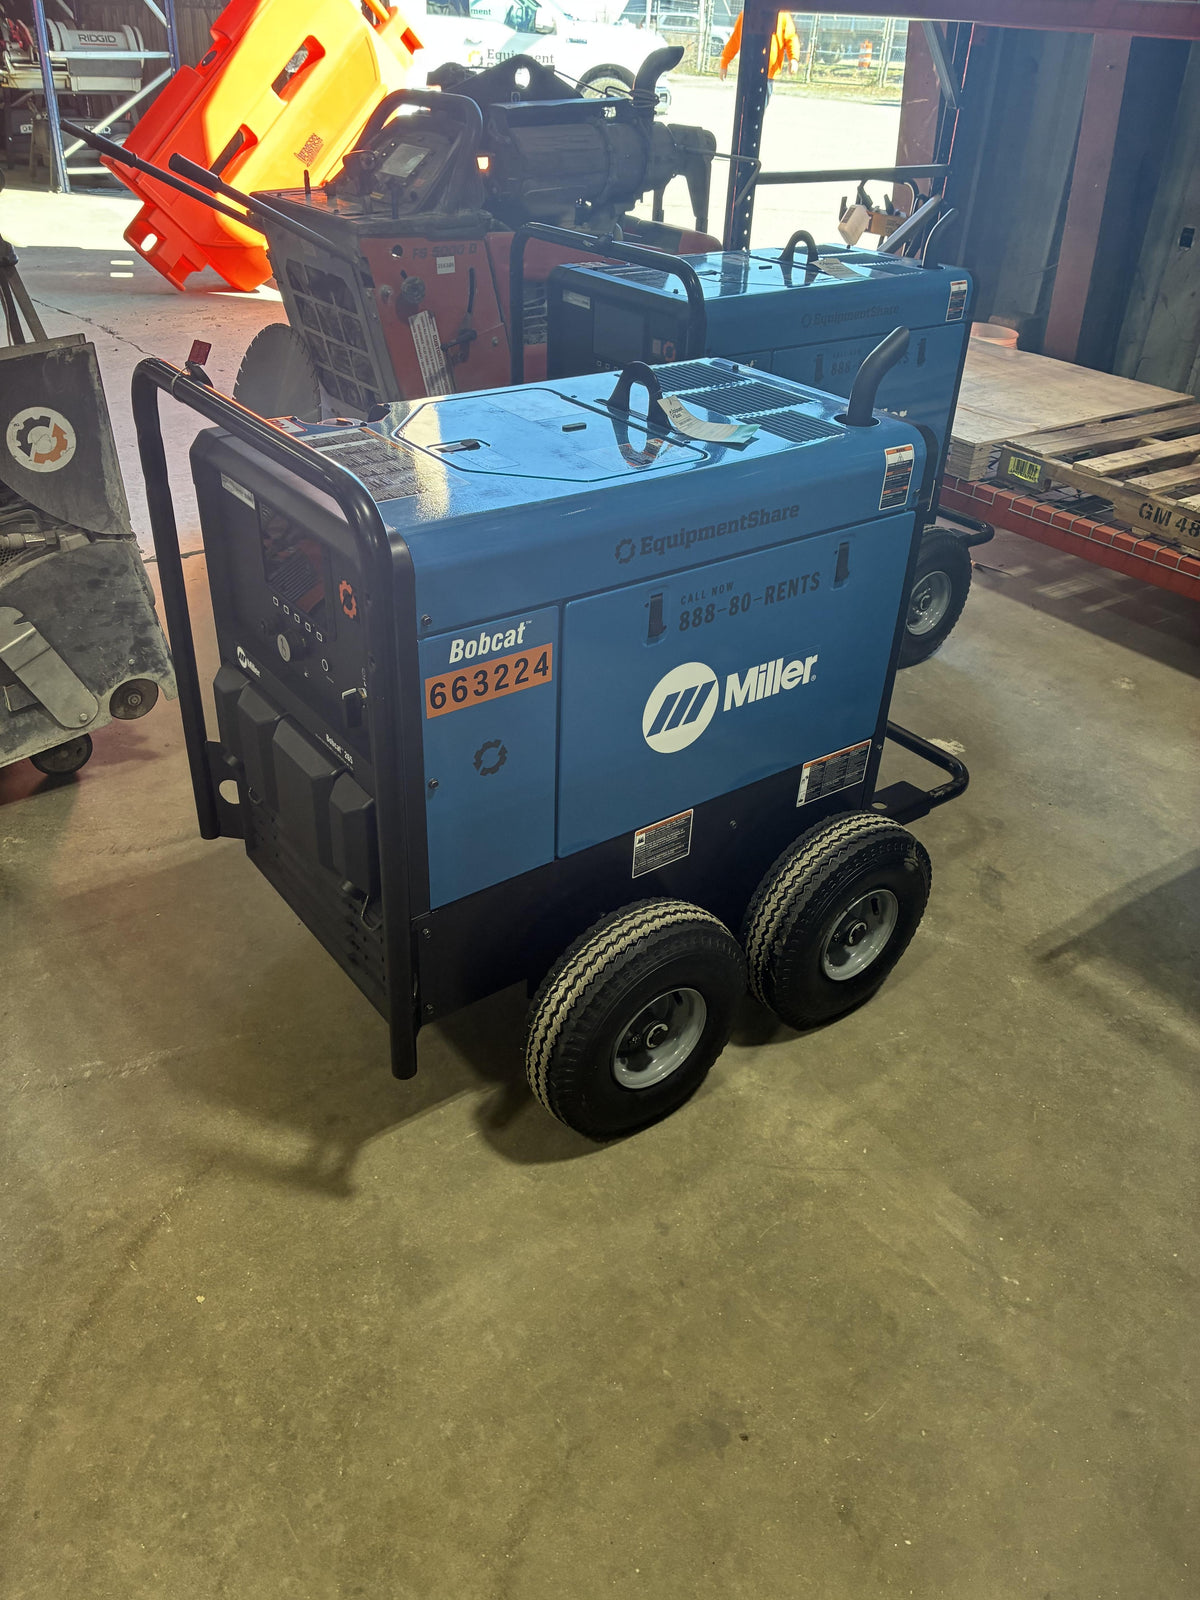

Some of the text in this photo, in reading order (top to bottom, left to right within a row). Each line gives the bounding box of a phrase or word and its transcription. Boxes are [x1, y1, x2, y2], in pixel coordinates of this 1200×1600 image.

[78, 33, 117, 43] RIDGID
[487, 49, 554, 64] Equient
[813, 305, 900, 327] EquipmentShare
[1138, 502, 1173, 527] GM
[639, 504, 800, 556] EquipmentShare
[678, 571, 821, 632] 888-80-RENTS
[680, 581, 735, 606] CALL NOW
[429, 651, 549, 710] 663224
